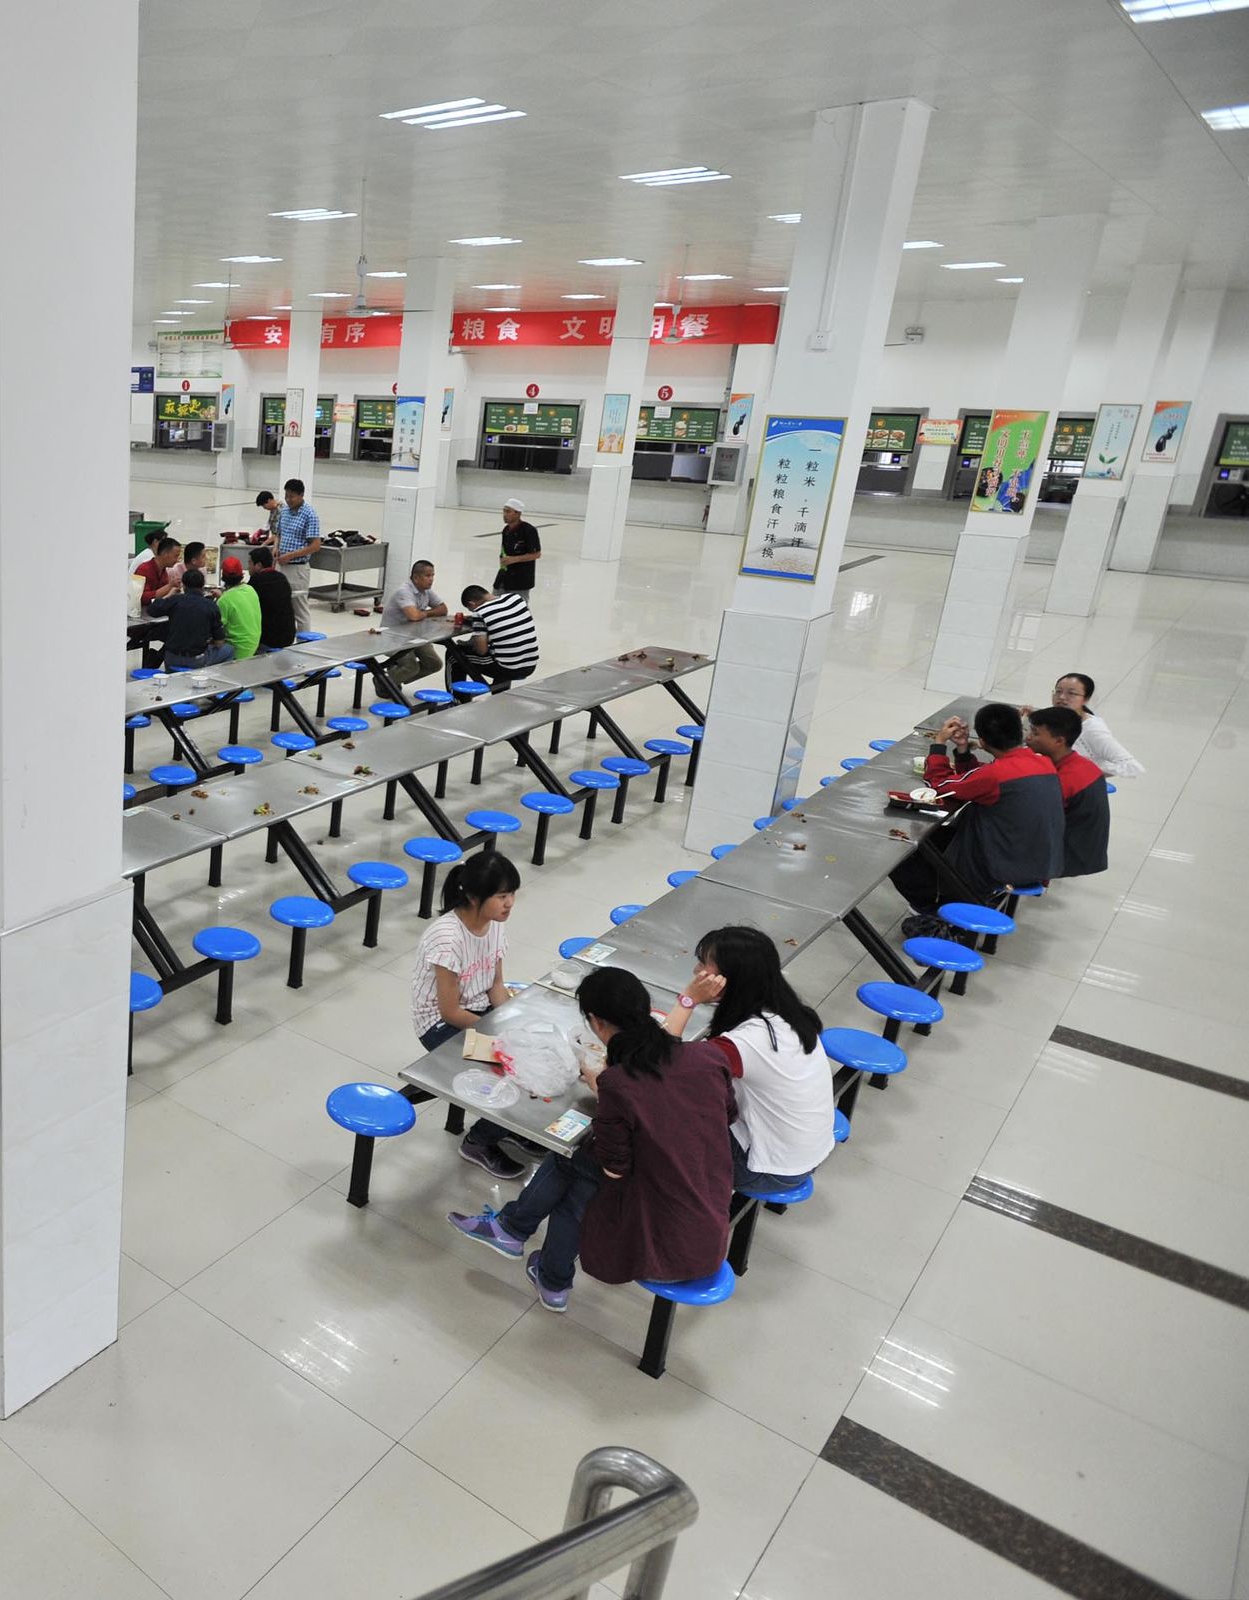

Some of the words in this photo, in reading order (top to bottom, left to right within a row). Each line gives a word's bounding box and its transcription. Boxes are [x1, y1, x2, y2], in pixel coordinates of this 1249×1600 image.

[761, 457, 791, 559] 粒粒粮食汗珠换
